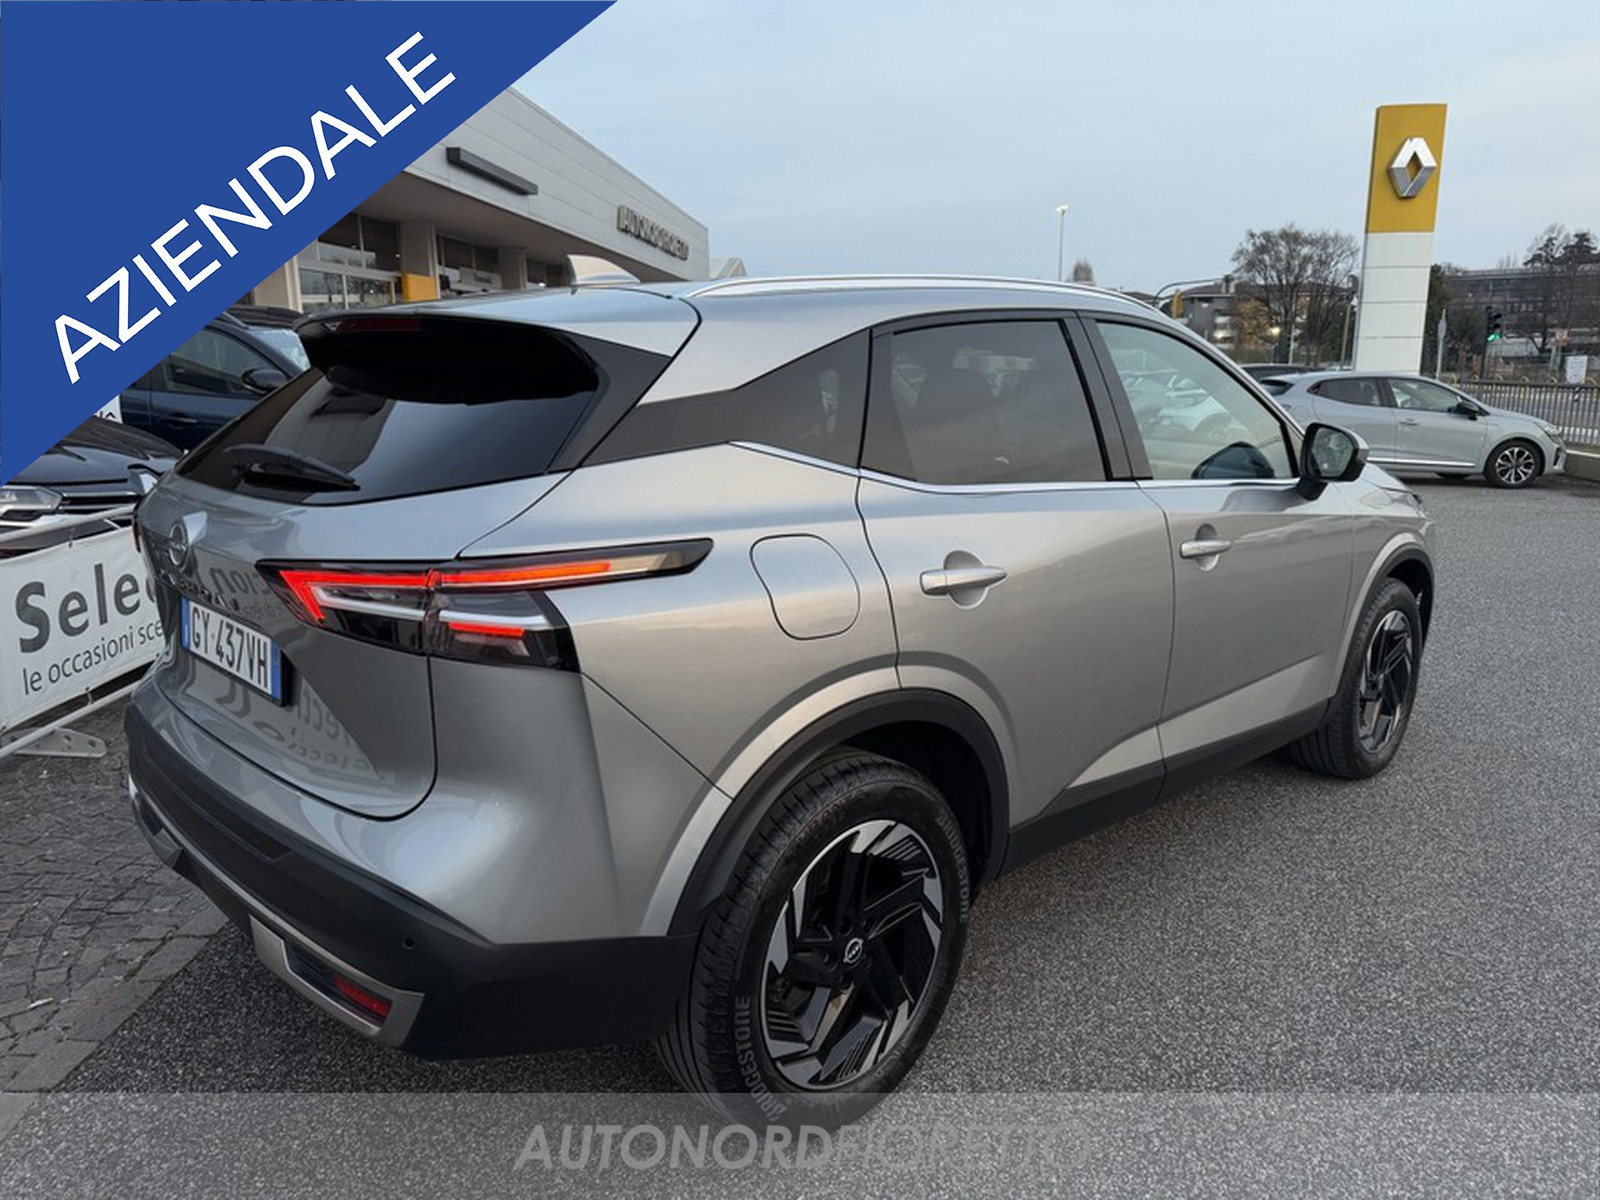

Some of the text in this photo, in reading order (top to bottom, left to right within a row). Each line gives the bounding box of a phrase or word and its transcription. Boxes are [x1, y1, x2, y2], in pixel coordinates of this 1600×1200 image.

[23, 668, 43, 695] le
[48, 625, 134, 684] occasioni
[192, 606, 268, 689] GY 437VH
[734, 996, 788, 1121] BRIDGESTONE
